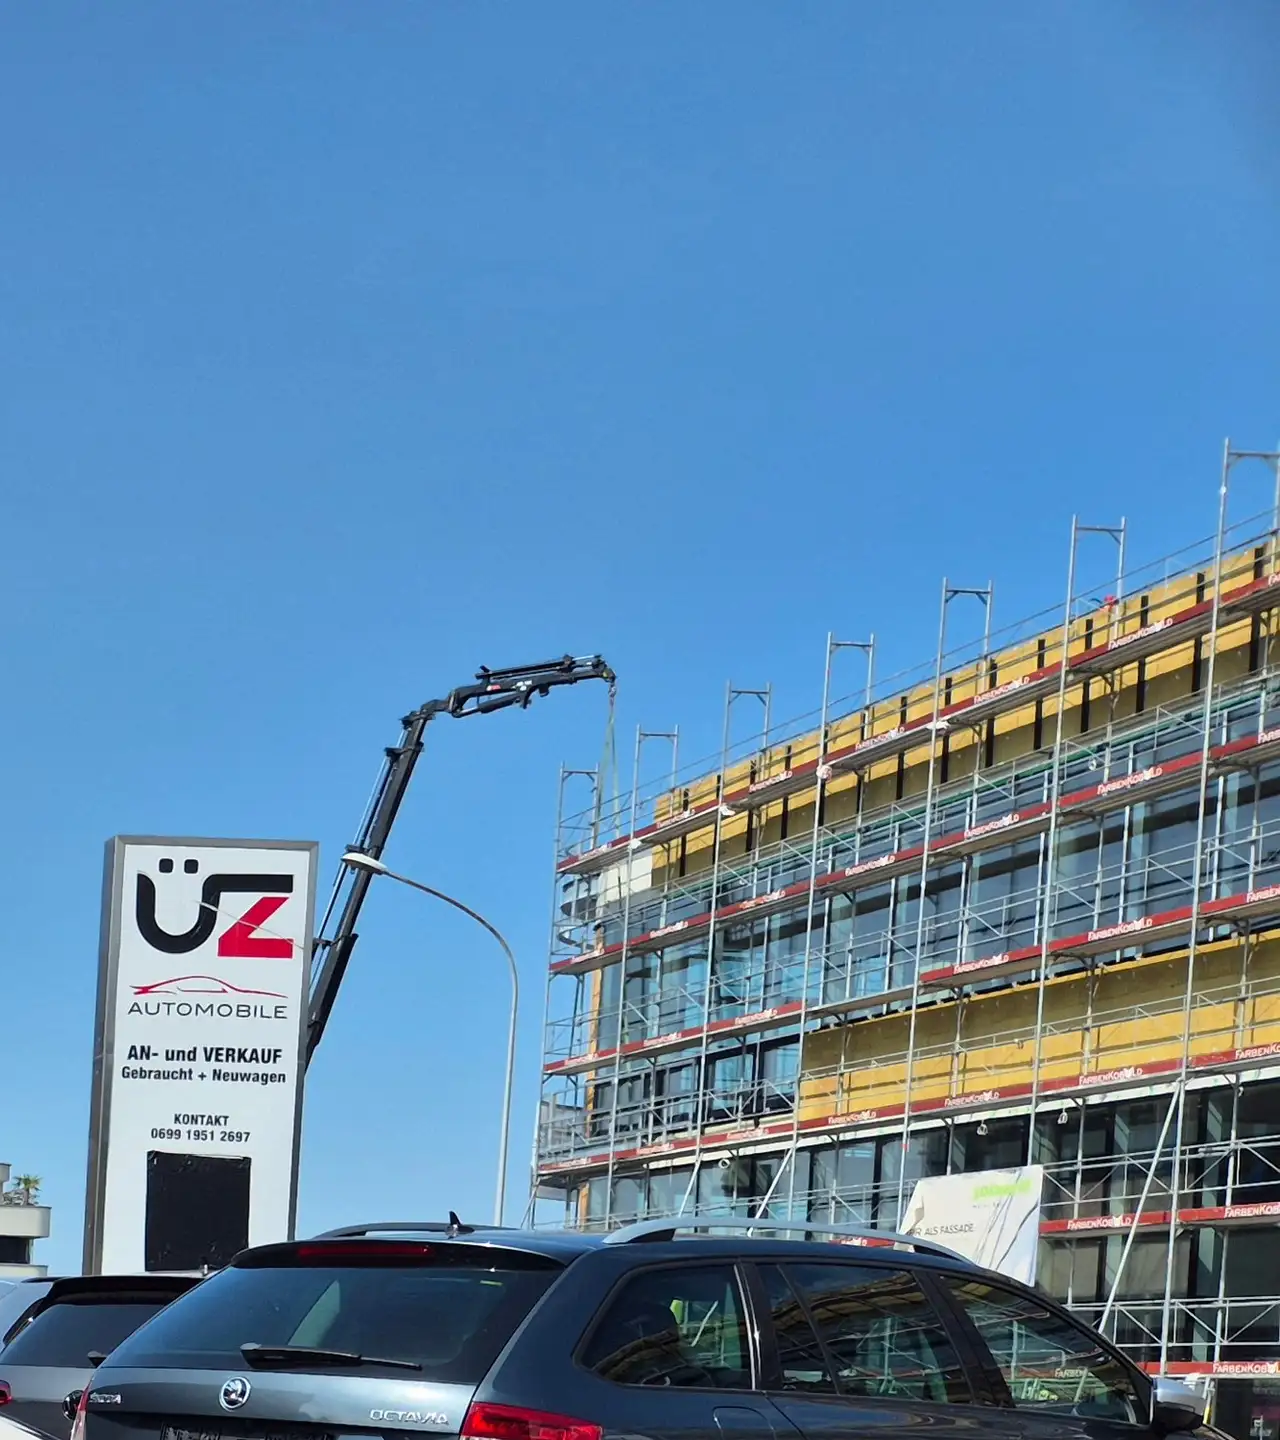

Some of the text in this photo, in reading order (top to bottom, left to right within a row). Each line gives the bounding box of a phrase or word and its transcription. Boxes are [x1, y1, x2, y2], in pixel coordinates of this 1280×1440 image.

[135, 858, 295, 959] ÜZ
[127, 1001, 289, 1020] AUTOMOBILE
[127, 1045, 284, 1065] AN- und VERKAUF
[121, 1066, 194, 1082] Gebraucht
[211, 1069, 287, 1085] Neuwagen
[173, 1112, 230, 1127] KONTAKT
[150, 1127, 251, 1144] 0699 1951 2697
[369, 1408, 450, 1426] OCTAVIA
